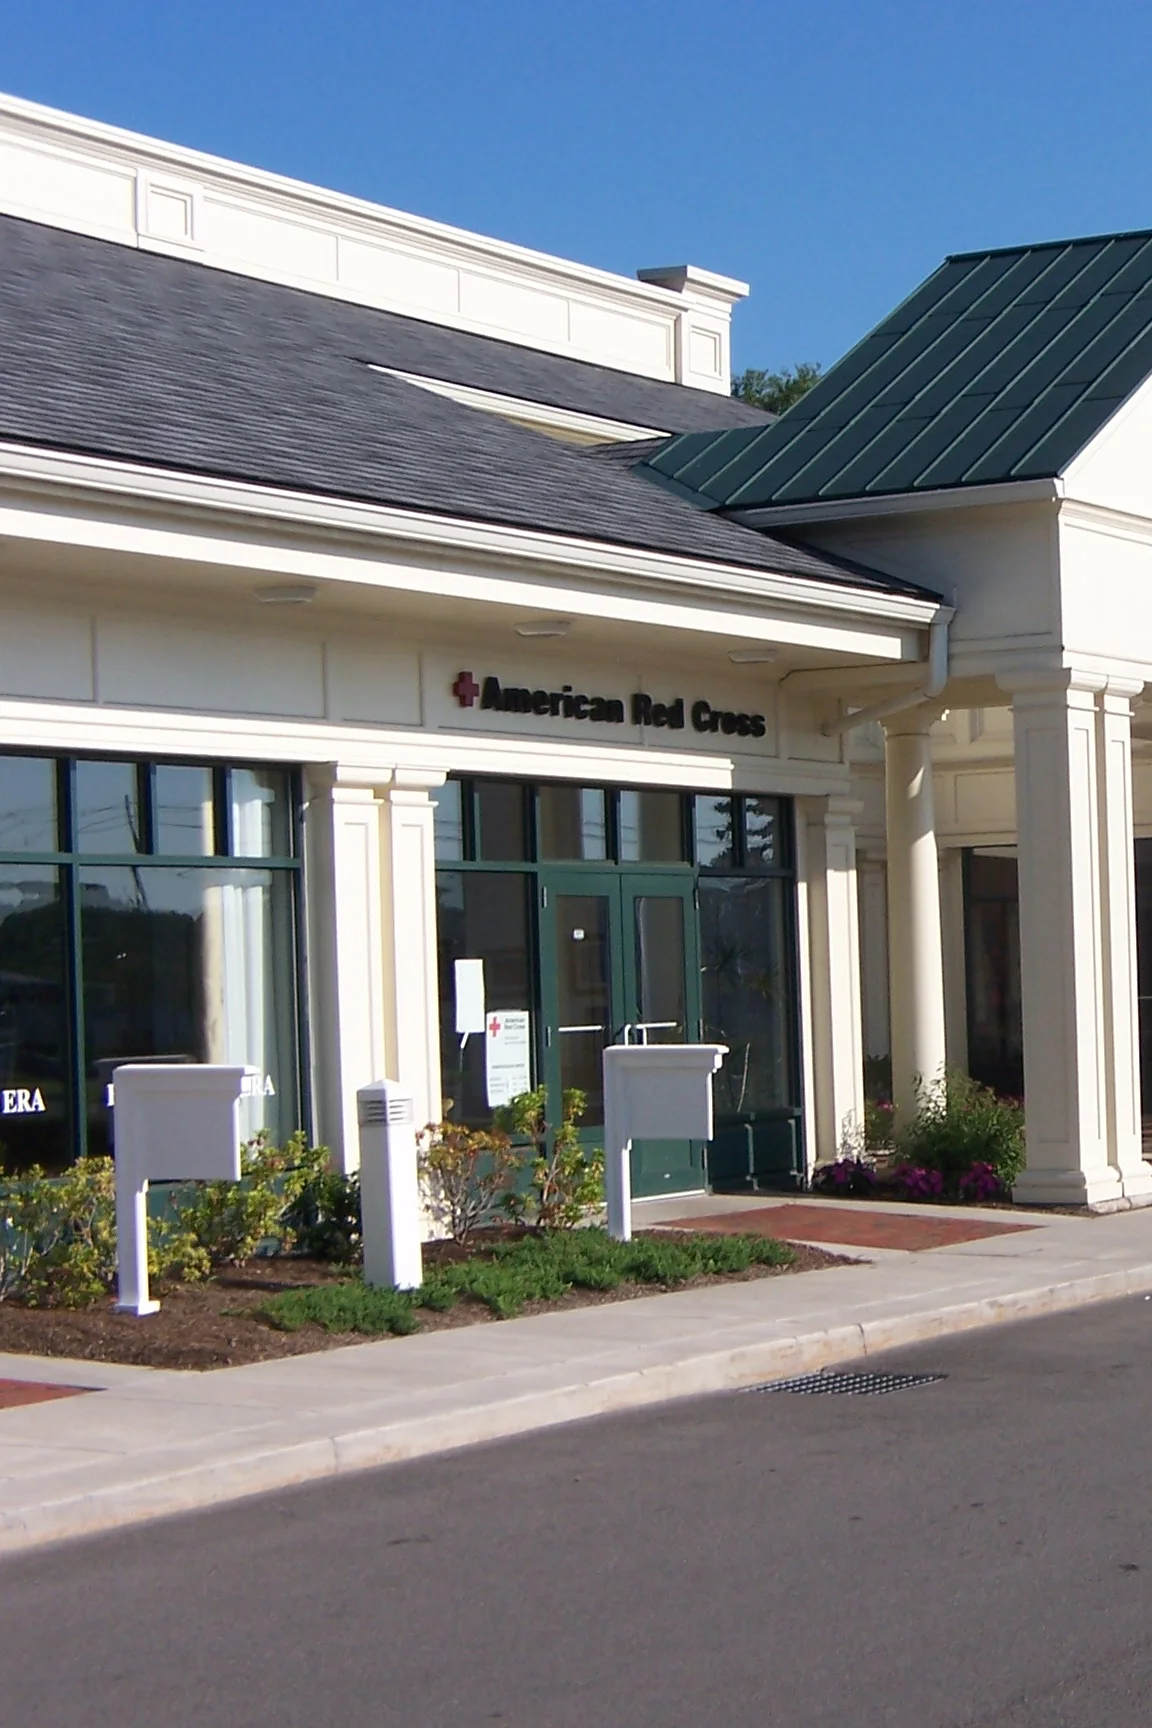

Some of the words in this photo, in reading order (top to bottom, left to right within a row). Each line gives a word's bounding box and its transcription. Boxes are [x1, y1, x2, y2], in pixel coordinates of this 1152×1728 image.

[480, 675, 625, 724] American
[631, 692, 685, 729] Red
[692, 700, 766, 738] Cross
[2, 1087, 46, 1114] ERA
